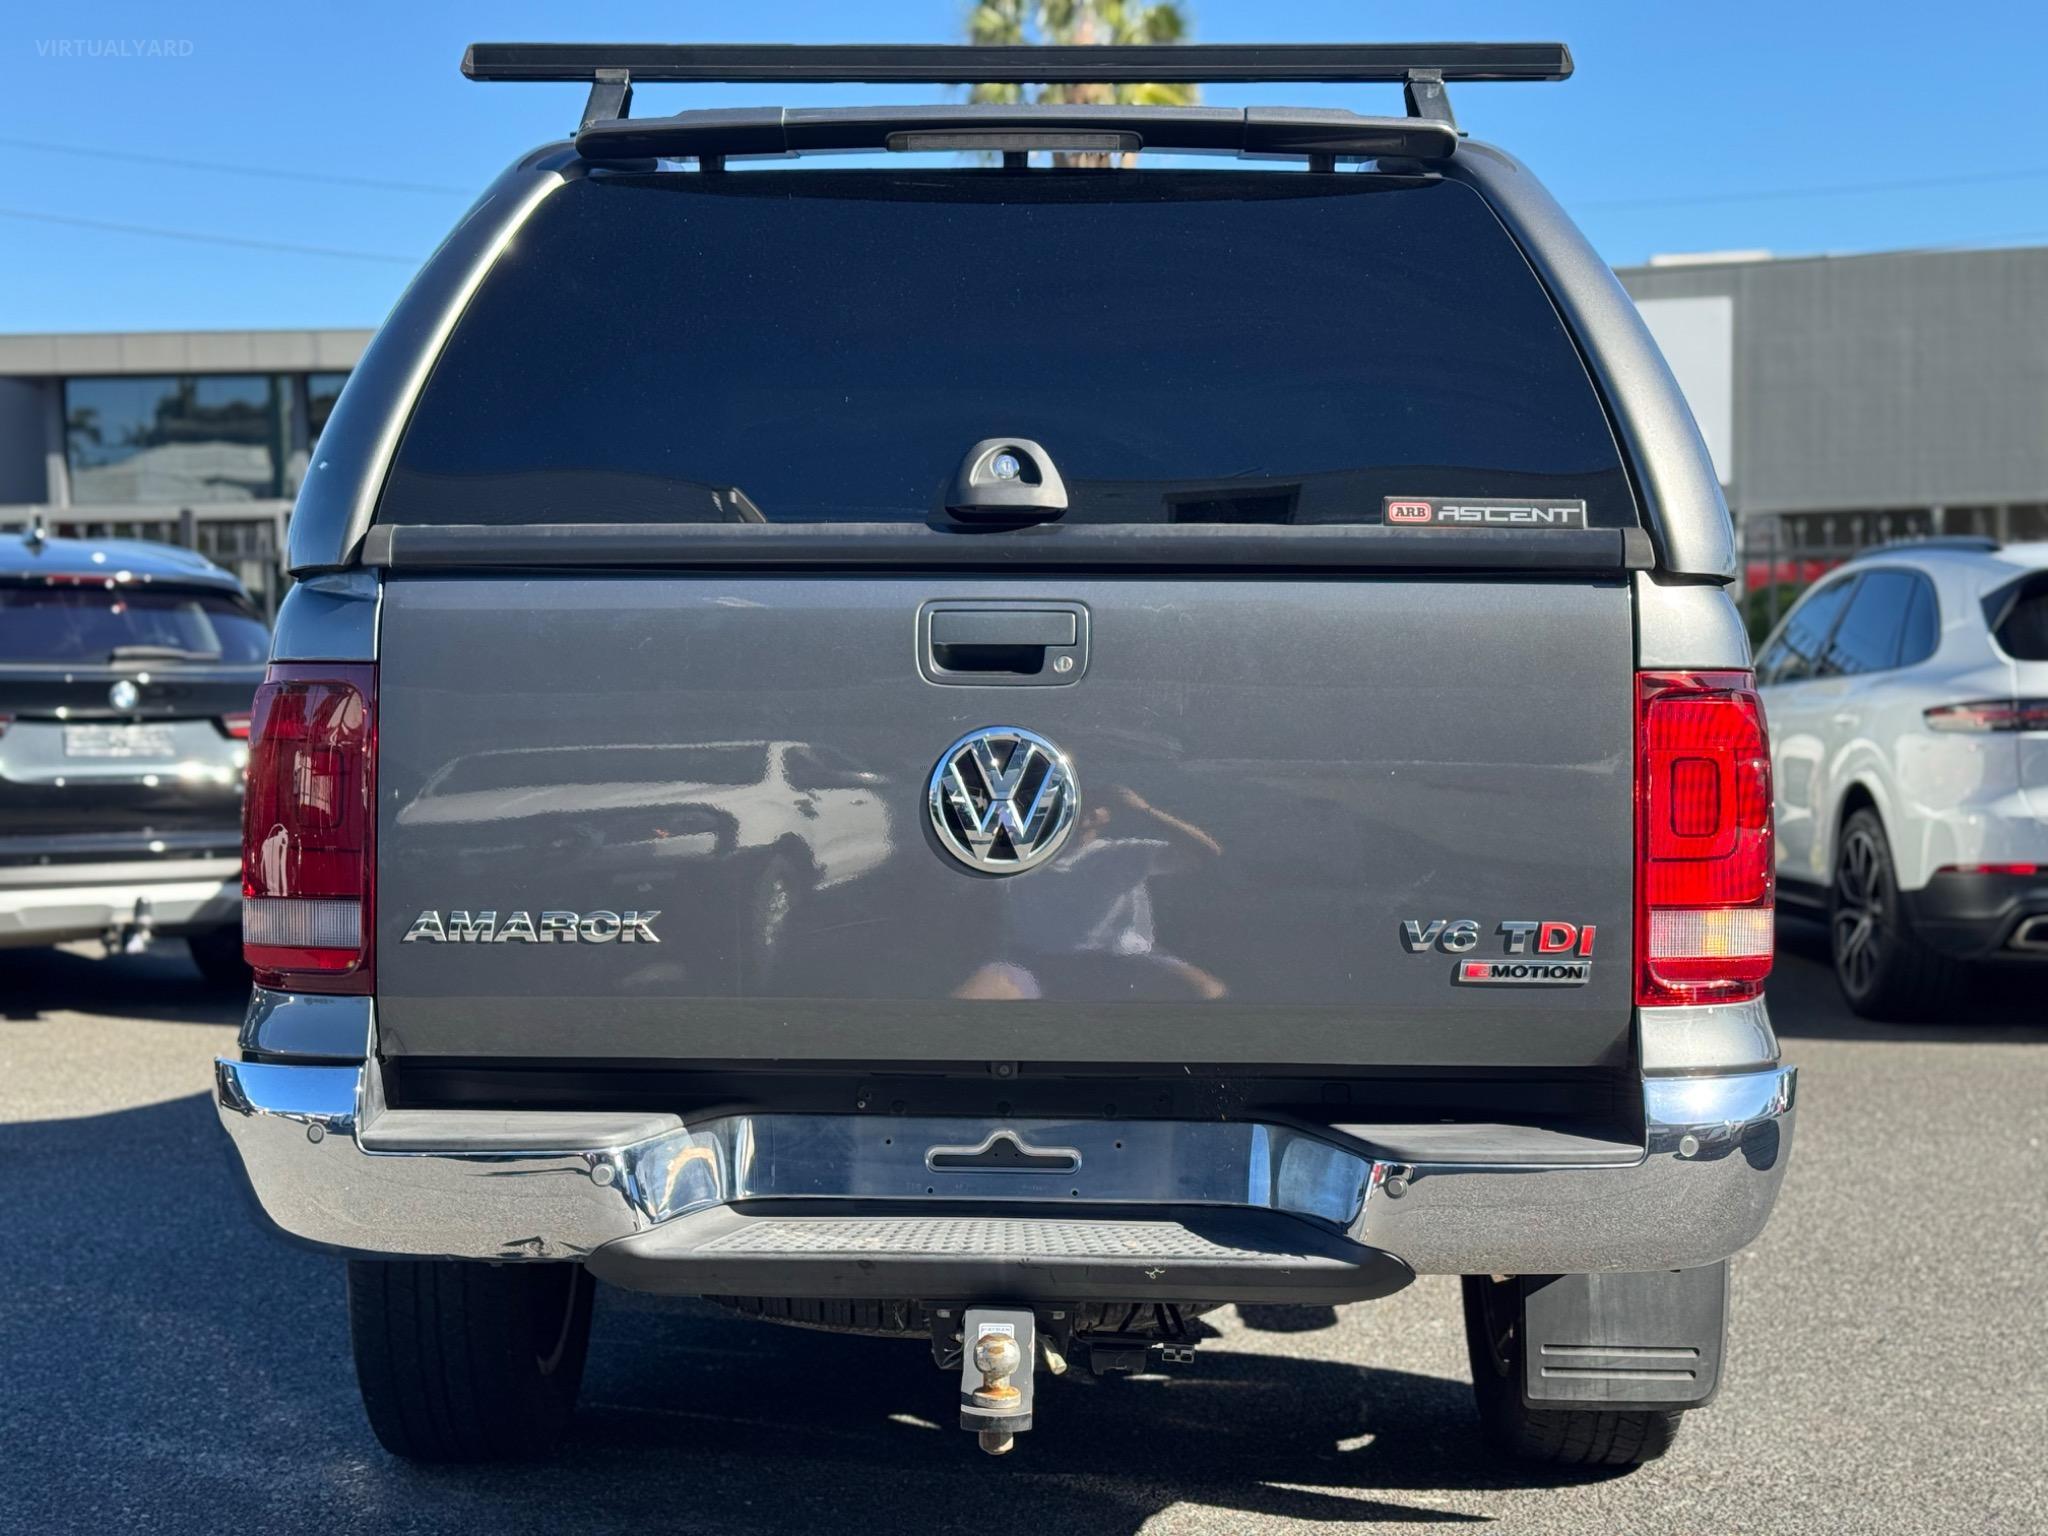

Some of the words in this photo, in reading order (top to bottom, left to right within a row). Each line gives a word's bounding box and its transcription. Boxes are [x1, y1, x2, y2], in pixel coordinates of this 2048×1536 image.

[1394, 506, 1427, 518] ARB
[1437, 505, 1581, 523] ASCENT
[931, 730, 1076, 871] VW
[402, 910, 662, 943] AMAROK
[1402, 919, 1481, 953] V6
[1501, 920, 1597, 957] TDI
